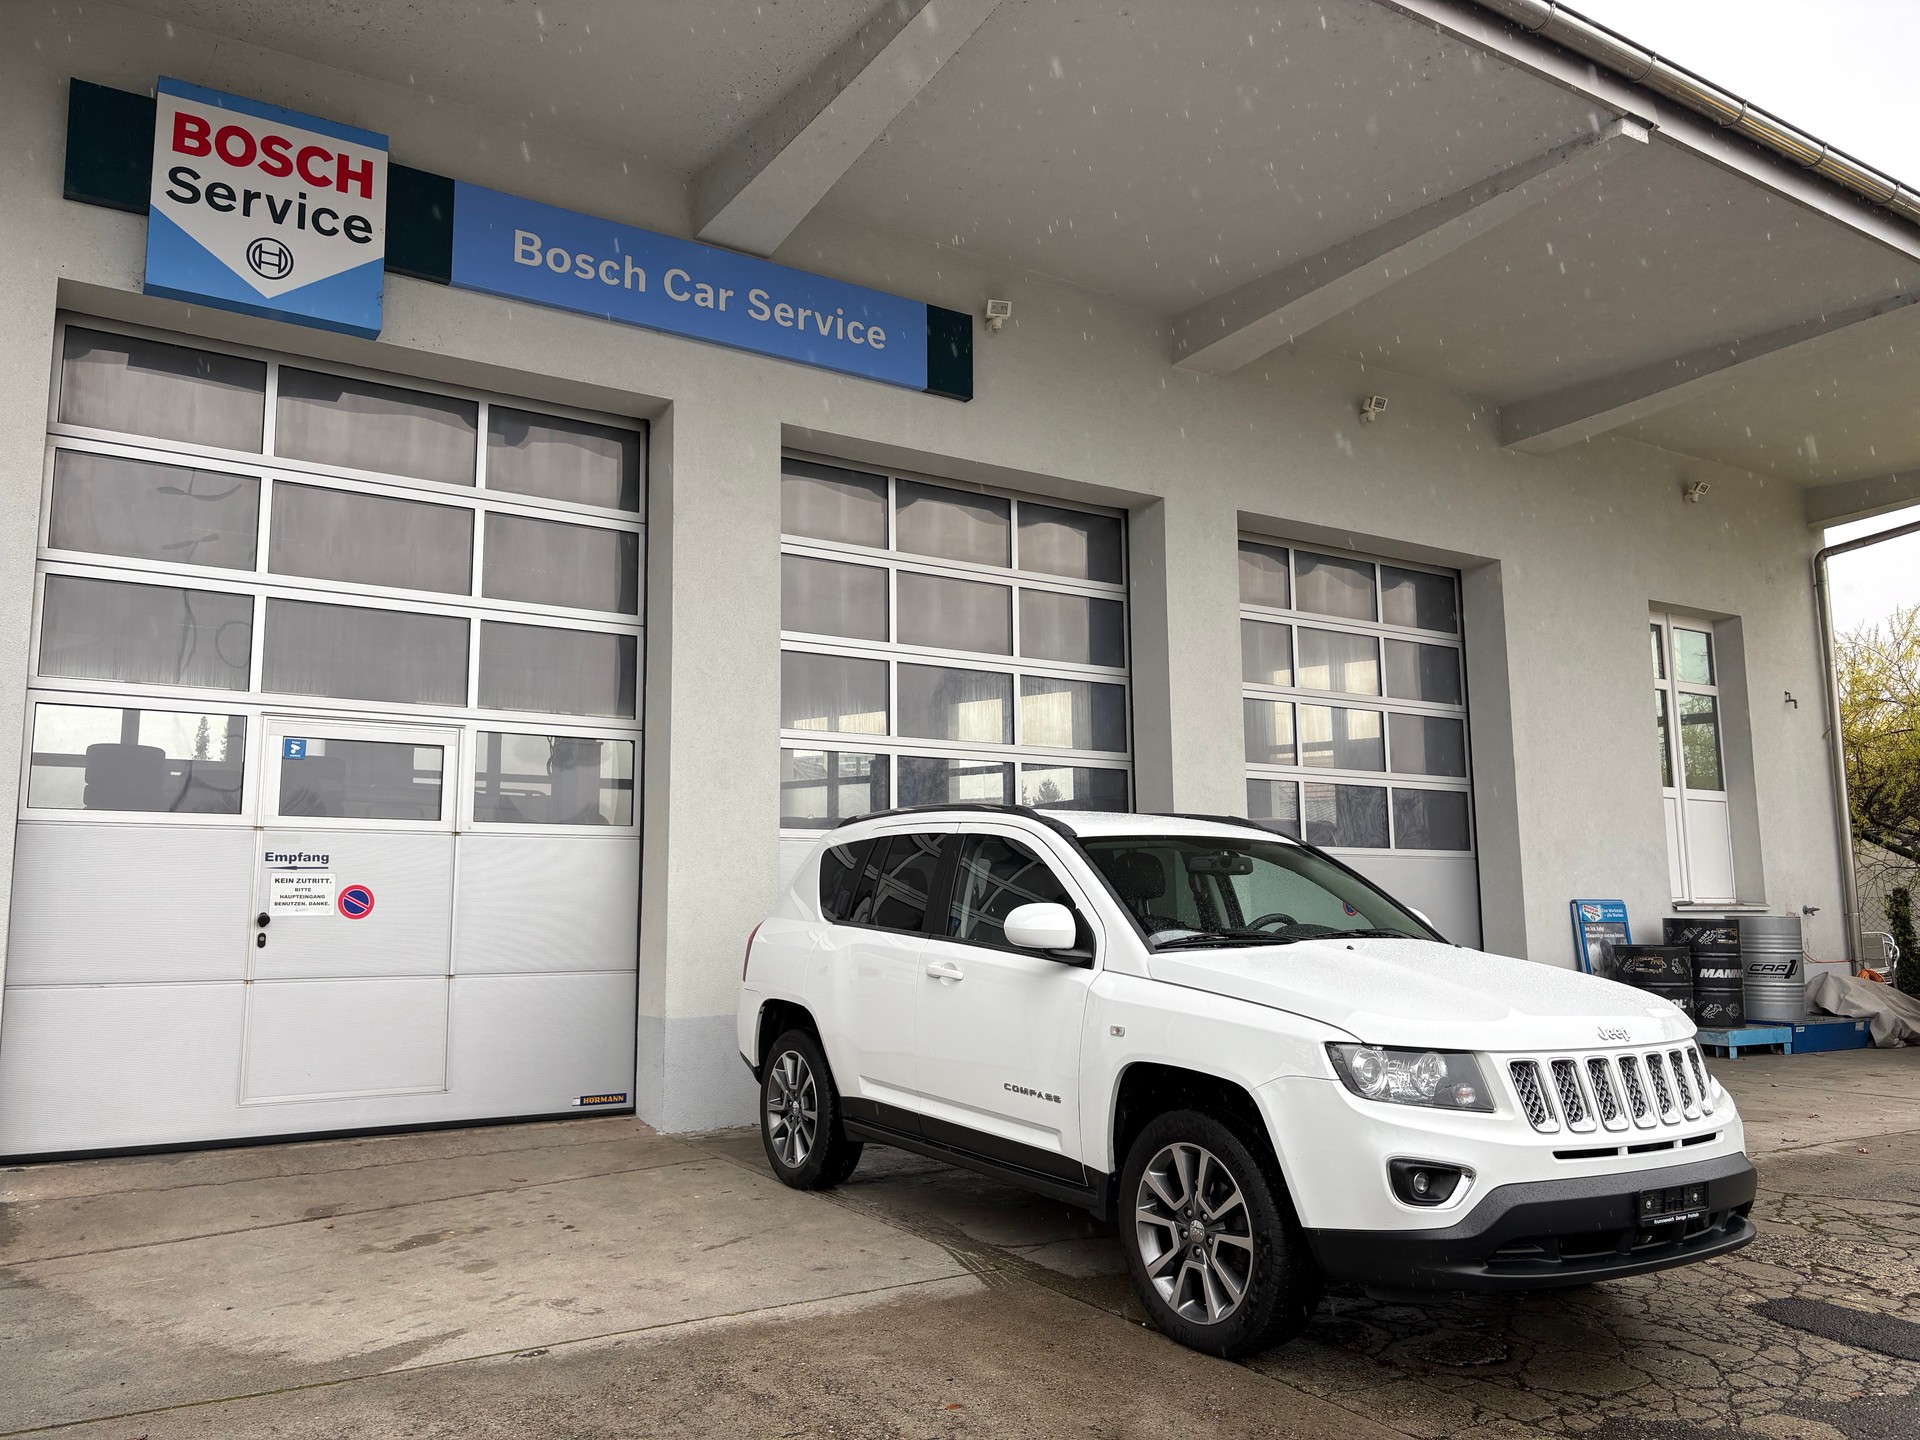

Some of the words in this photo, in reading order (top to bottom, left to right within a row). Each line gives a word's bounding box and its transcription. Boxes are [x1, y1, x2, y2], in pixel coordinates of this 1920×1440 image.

[172, 111, 374, 200] BOSCH
[165, 166, 373, 244] Service
[513, 228, 647, 293] Bosch
[662, 268, 735, 312] Car
[747, 288, 887, 350] Service
[265, 851, 330, 864] Empfang
[1597, 1025, 1631, 1042] Jeep
[1003, 1082, 1062, 1104] COMPASS
